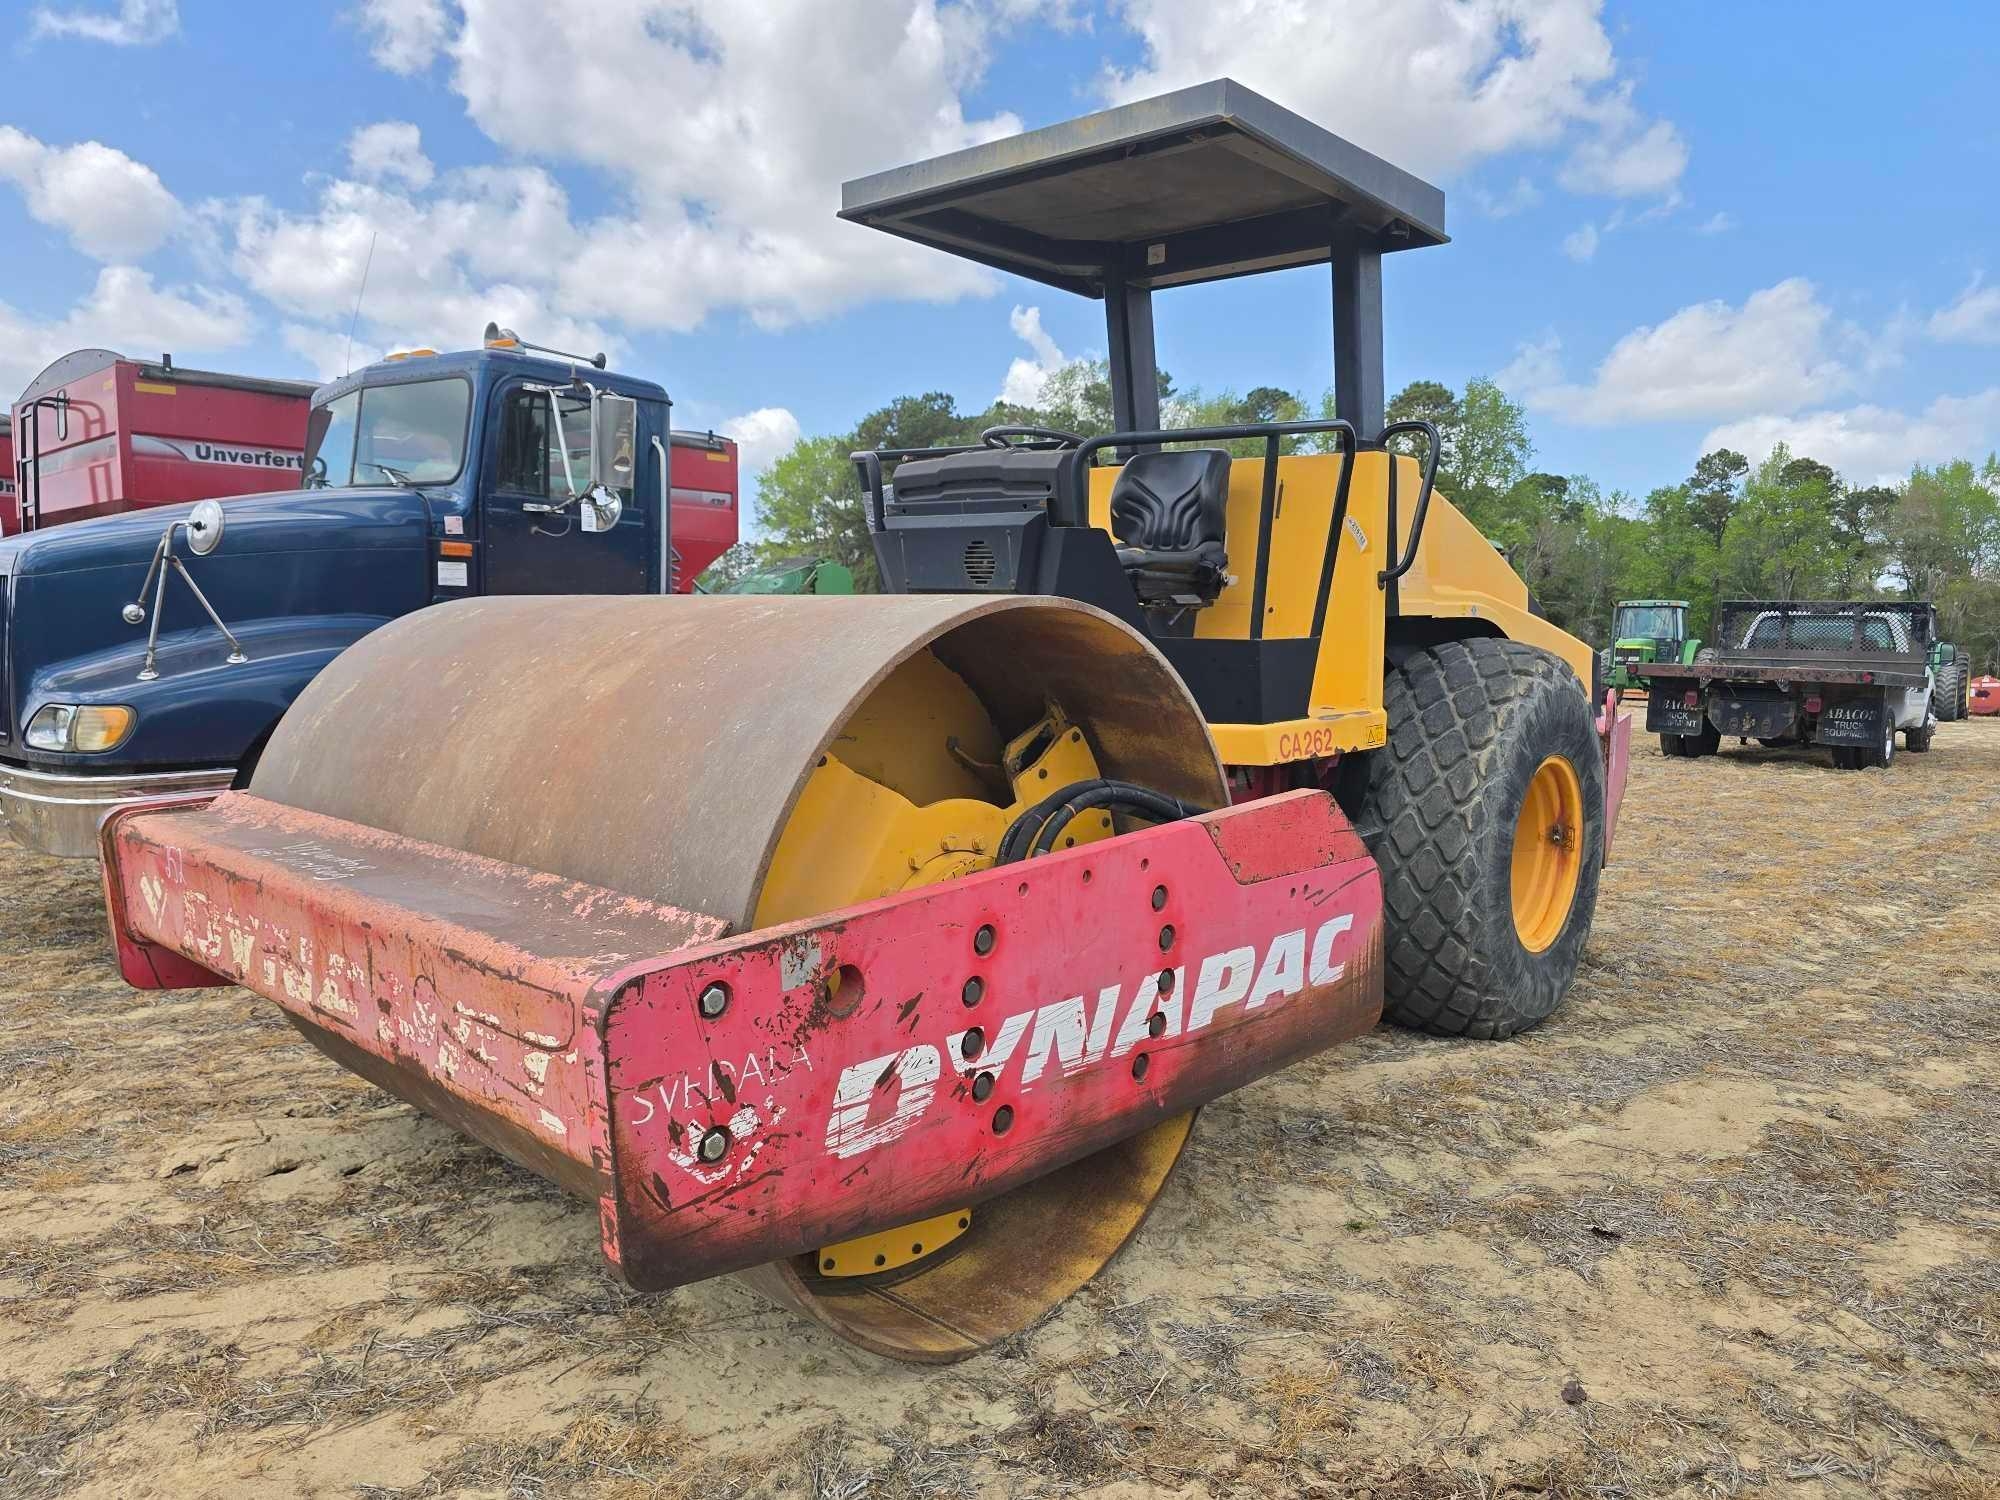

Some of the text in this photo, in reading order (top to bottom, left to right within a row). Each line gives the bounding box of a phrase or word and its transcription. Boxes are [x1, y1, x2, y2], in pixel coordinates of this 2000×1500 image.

[1280, 727, 1334, 760] CA262
[824, 913, 1354, 1160] DYNAPAC
[631, 1045, 813, 1125] SVEDALA
